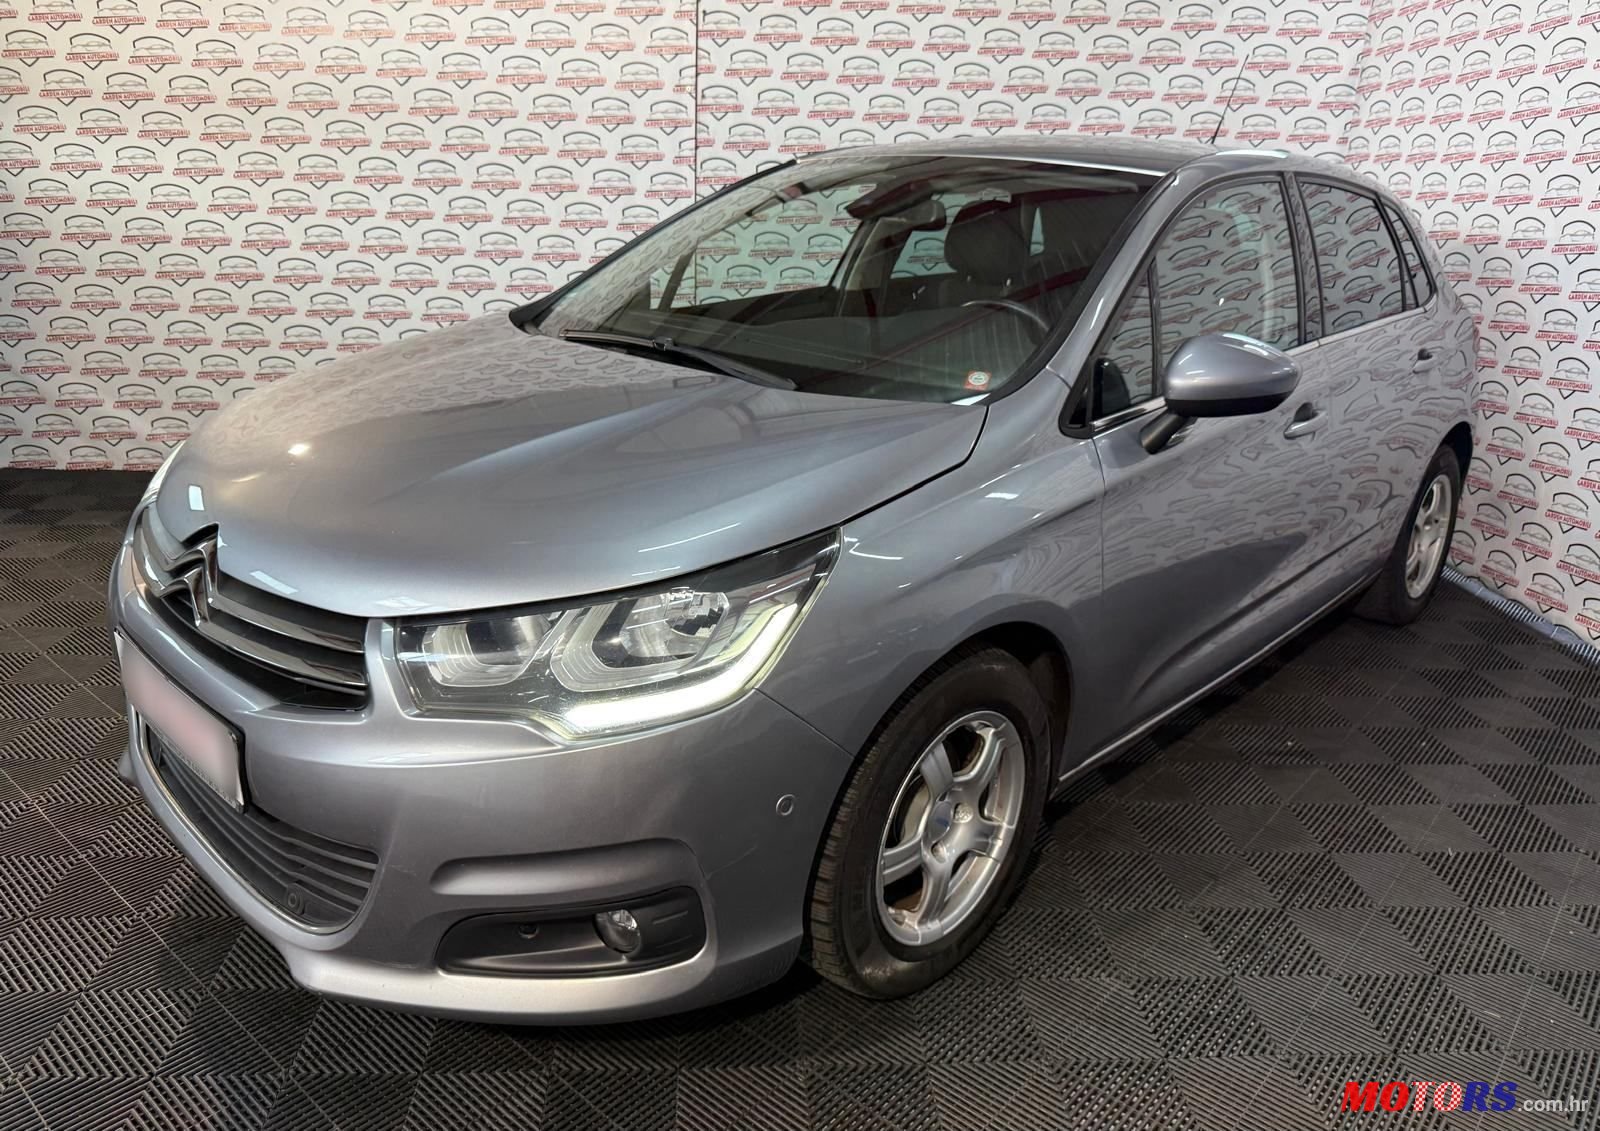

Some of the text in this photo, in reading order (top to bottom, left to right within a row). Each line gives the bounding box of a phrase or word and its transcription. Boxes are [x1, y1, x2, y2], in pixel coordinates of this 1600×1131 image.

[1544, 14, 1572, 28] AUTOMOBILI
[1559, 57, 1588, 70] AUTOMOBILI
[1526, 106, 1552, 117] AUTOMOBILI
[1540, 150, 1567, 160] AUTOMOBILI
[1554, 197, 1583, 205] AUTOMOBILI
[1564, 383, 1592, 391] AUTOMOBILI
[1531, 418, 1558, 427] AUTOMOBILI
[1545, 466, 1572, 476] AUTOMOBILI
[1562, 517, 1592, 529] AUTOMOBILI
[1527, 546, 1553, 558] AUTOMOBILI
[1541, 597, 1568, 611] AUTOMOBILI
